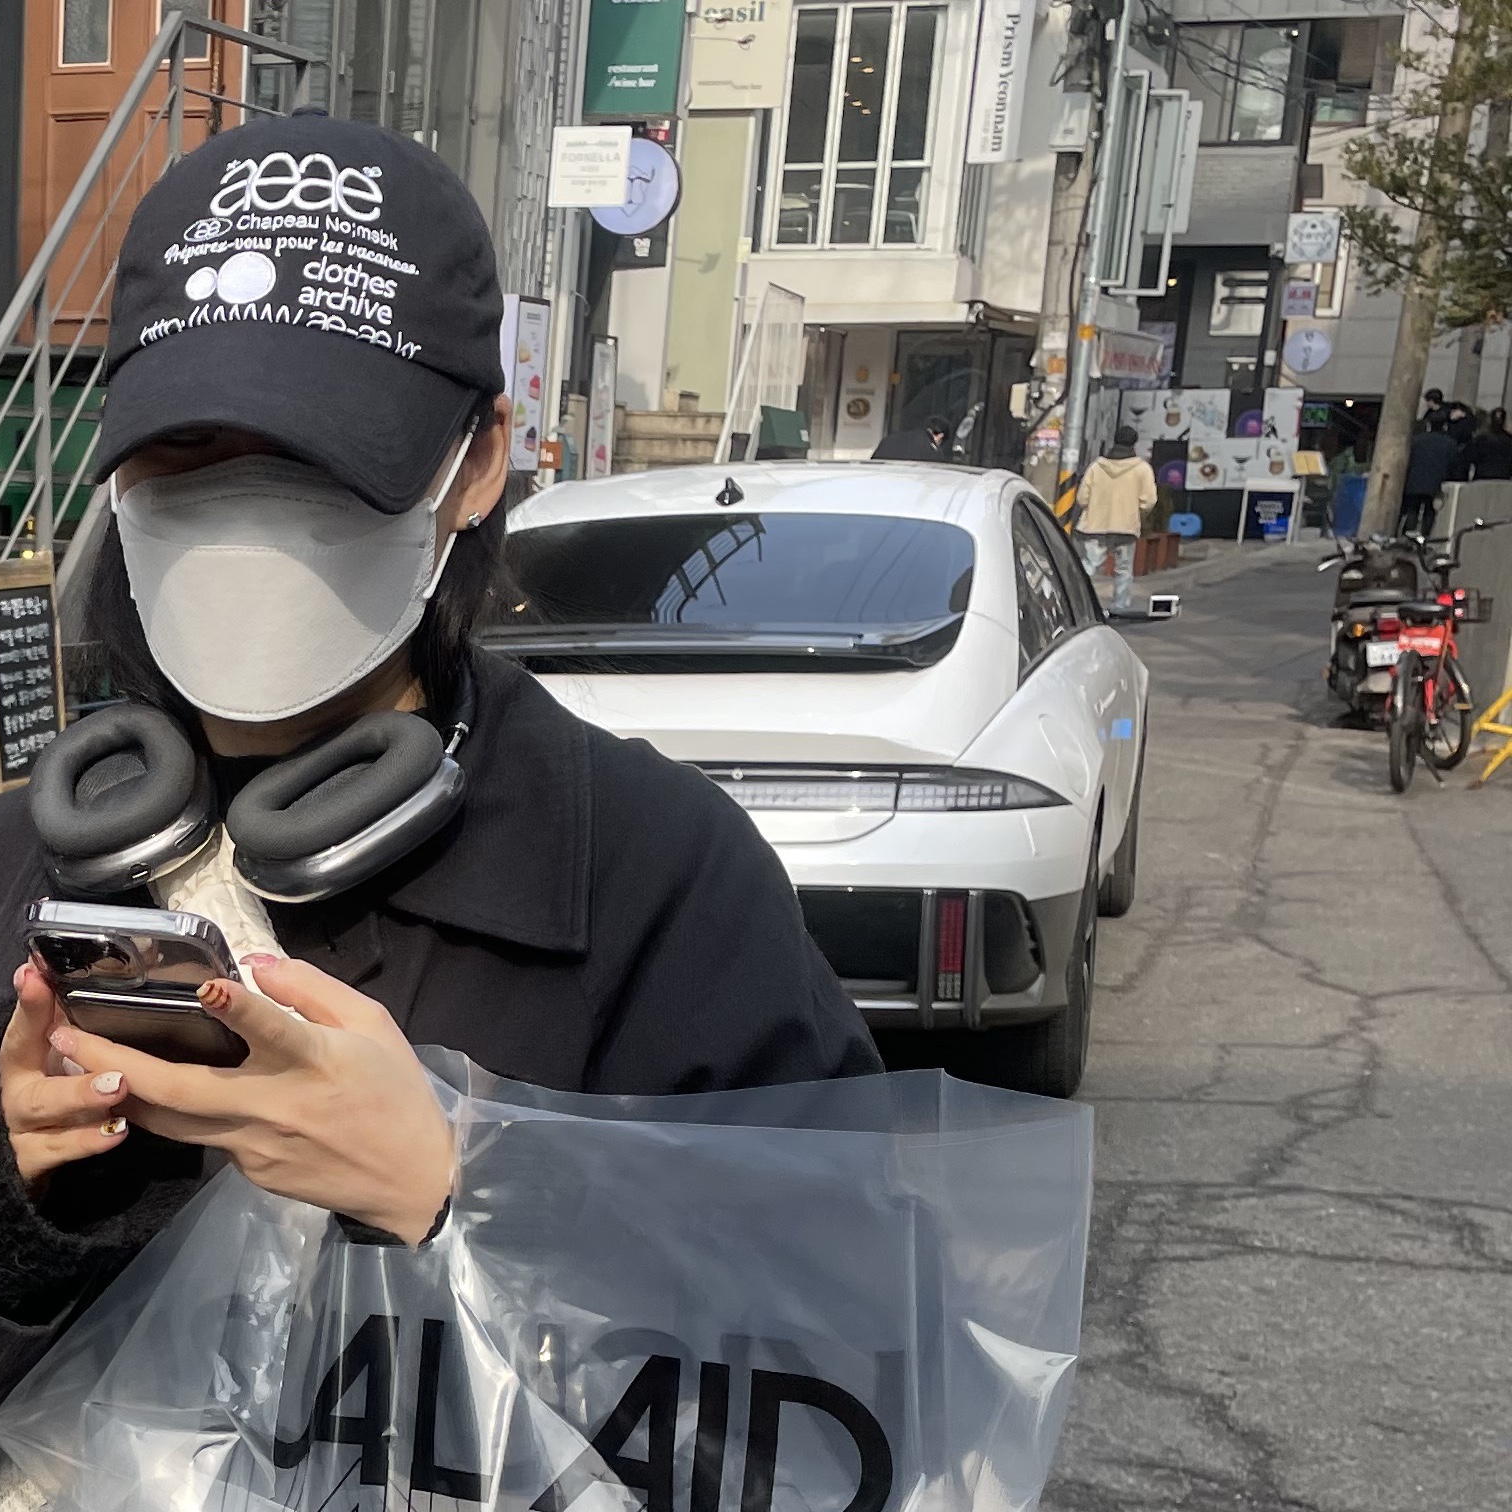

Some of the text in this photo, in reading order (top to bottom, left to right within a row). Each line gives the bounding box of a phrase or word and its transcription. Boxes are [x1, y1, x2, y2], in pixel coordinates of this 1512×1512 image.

[236, 213, 319, 232] Chapeau
[275, 236, 318, 257] pour
[320, 232, 344, 254] les
[303, 255, 398, 299] clothes
[298, 286, 393, 325] archive
